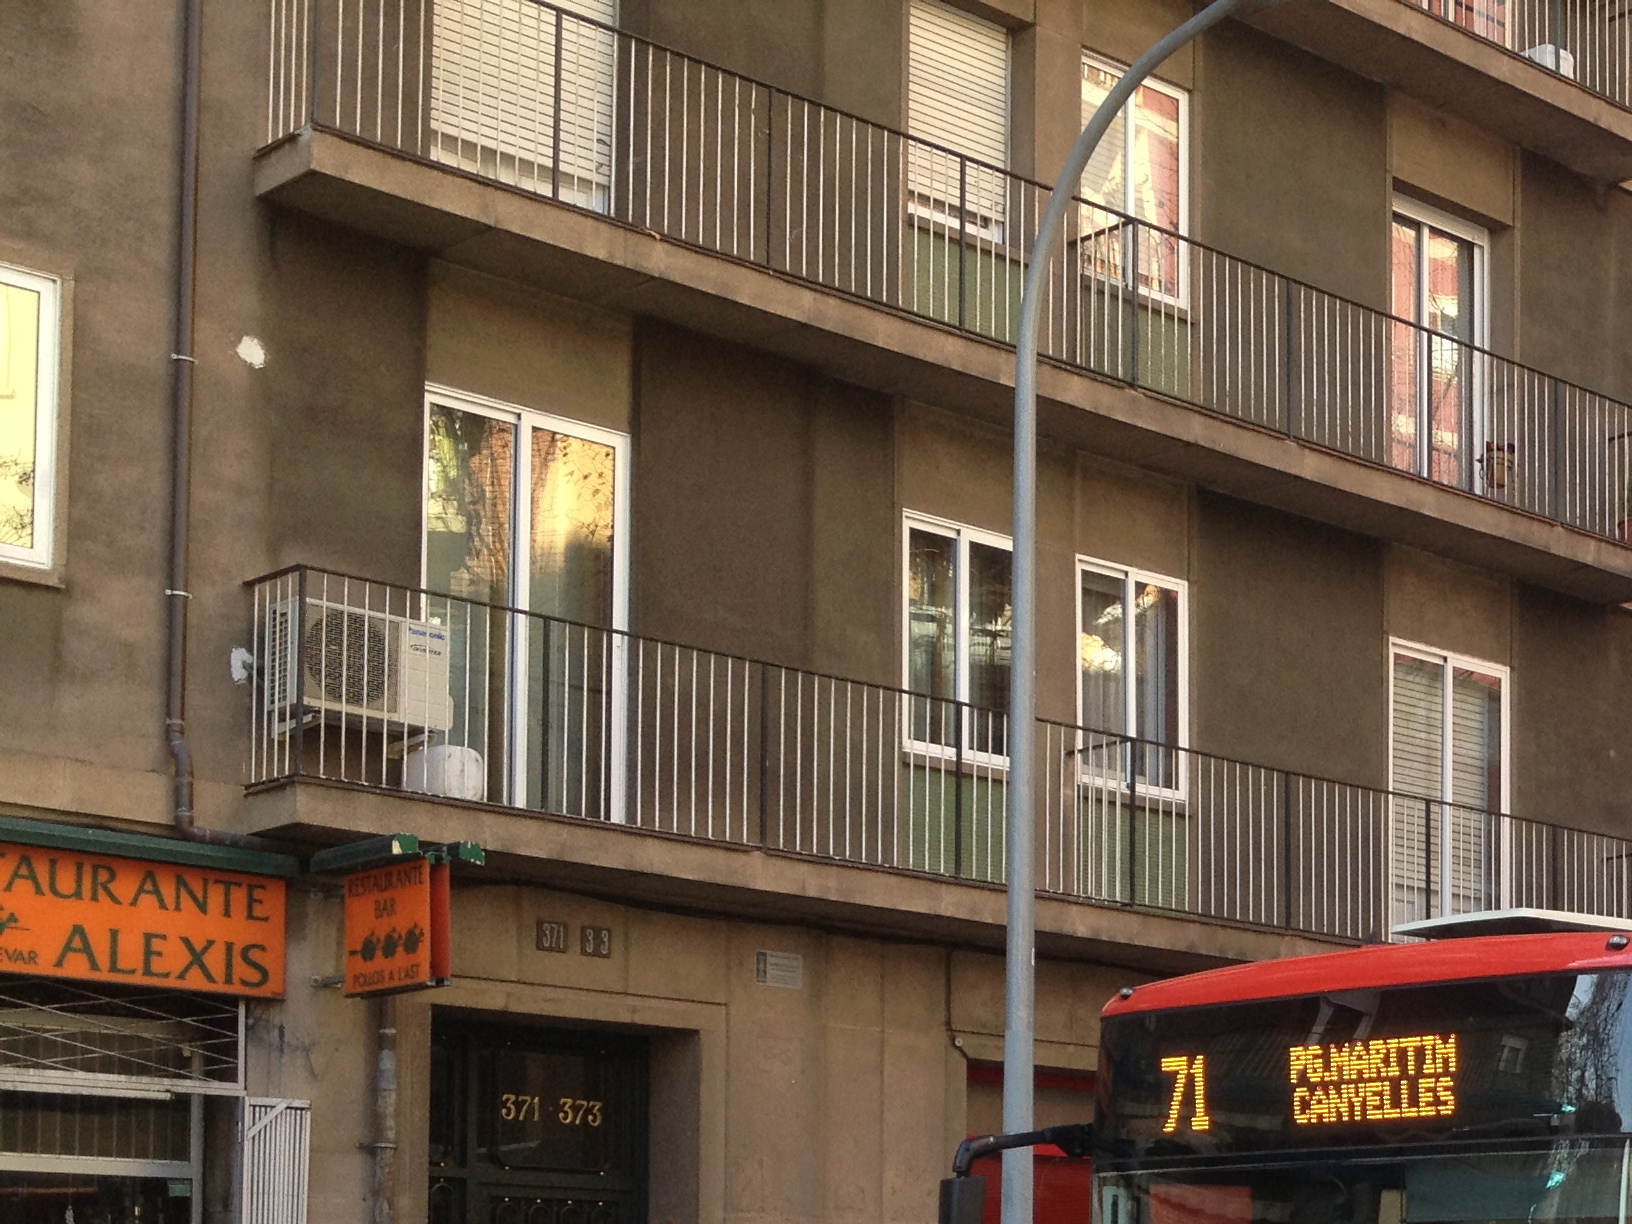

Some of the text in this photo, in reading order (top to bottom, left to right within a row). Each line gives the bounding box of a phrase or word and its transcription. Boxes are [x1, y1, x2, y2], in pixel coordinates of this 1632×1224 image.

[0, 854, 270, 922] AURANTE
[348, 864, 424, 897] RESTAURANTE
[374, 897, 397, 919] BAR
[53, 924, 270, 988] ALEXIS
[542, 923, 564, 949] 371
[1289, 1033, 1457, 1083] PG.MARITIM
[502, 1094, 602, 1127] 371 373
[1160, 1055, 1209, 1132] 71
[1293, 1076, 1455, 1124] CANYELLES
